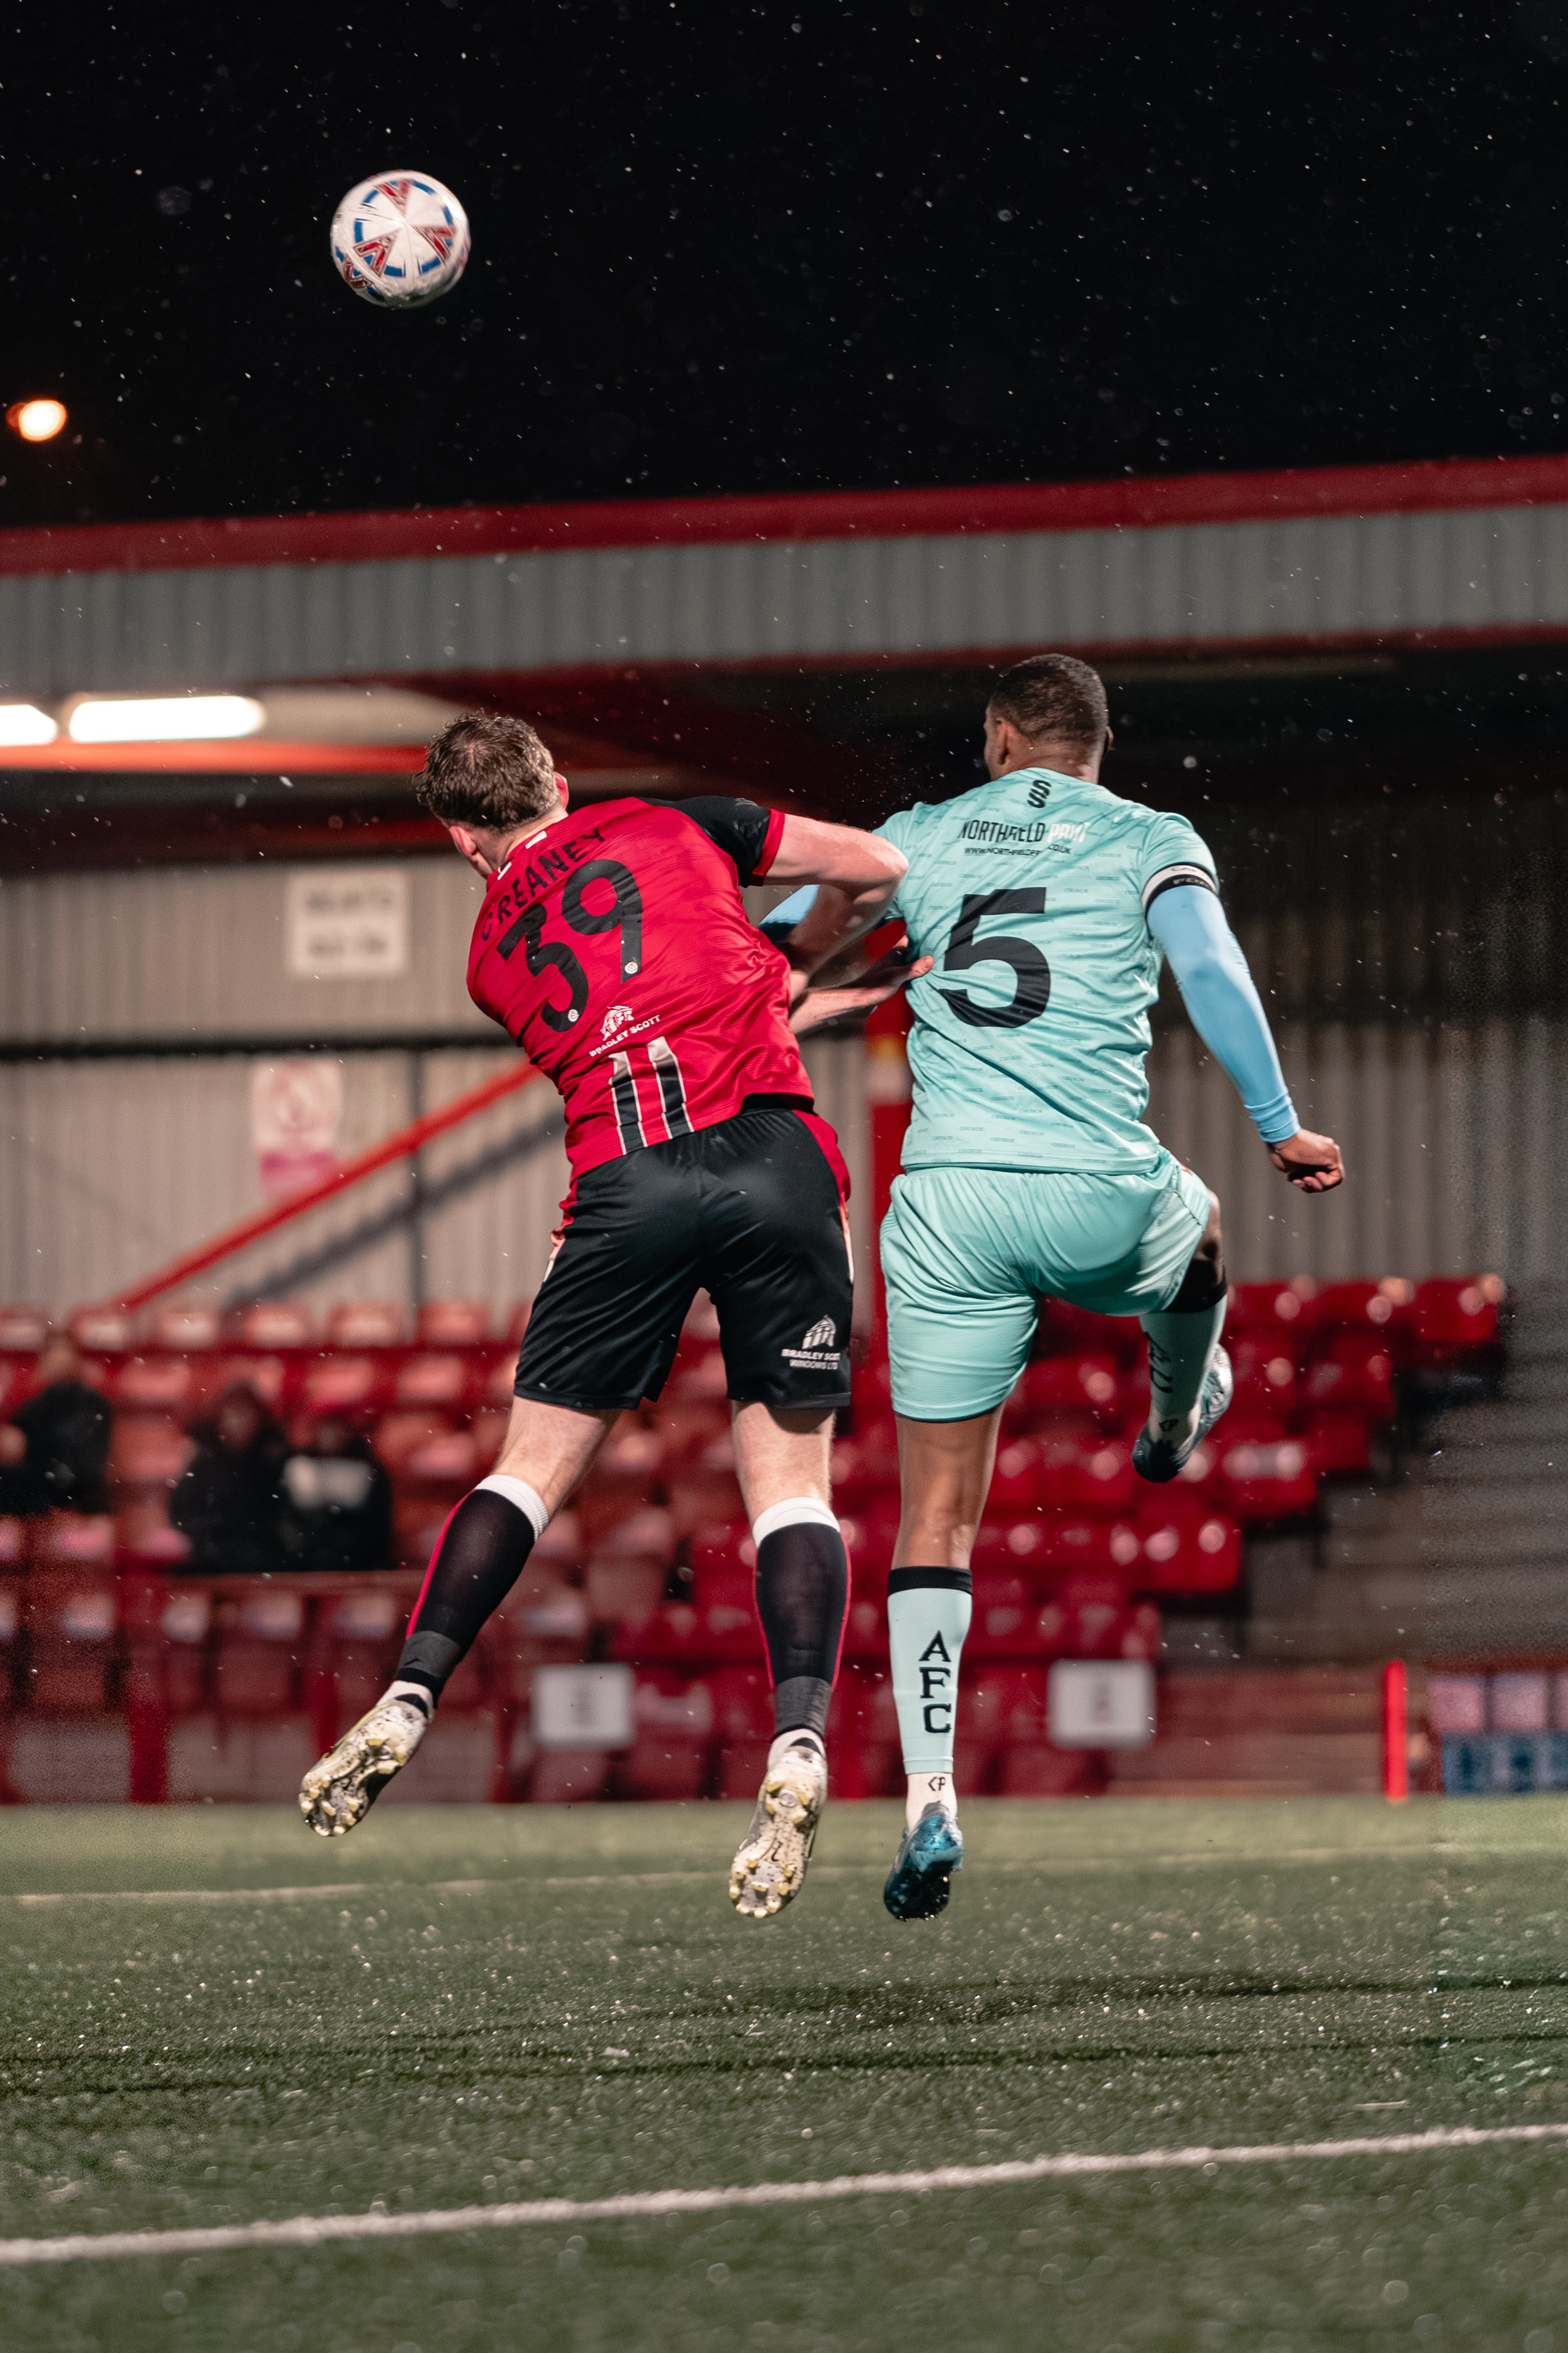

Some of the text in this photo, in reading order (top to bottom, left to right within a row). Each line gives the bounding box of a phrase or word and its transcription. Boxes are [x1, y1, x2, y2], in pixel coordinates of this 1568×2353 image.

[482, 827, 605, 941] CREANEY
[496, 859, 642, 1032] 39
[939, 886, 1050, 1028] 5
[589, 1014, 660, 1057] BRADLEY SCOTT
